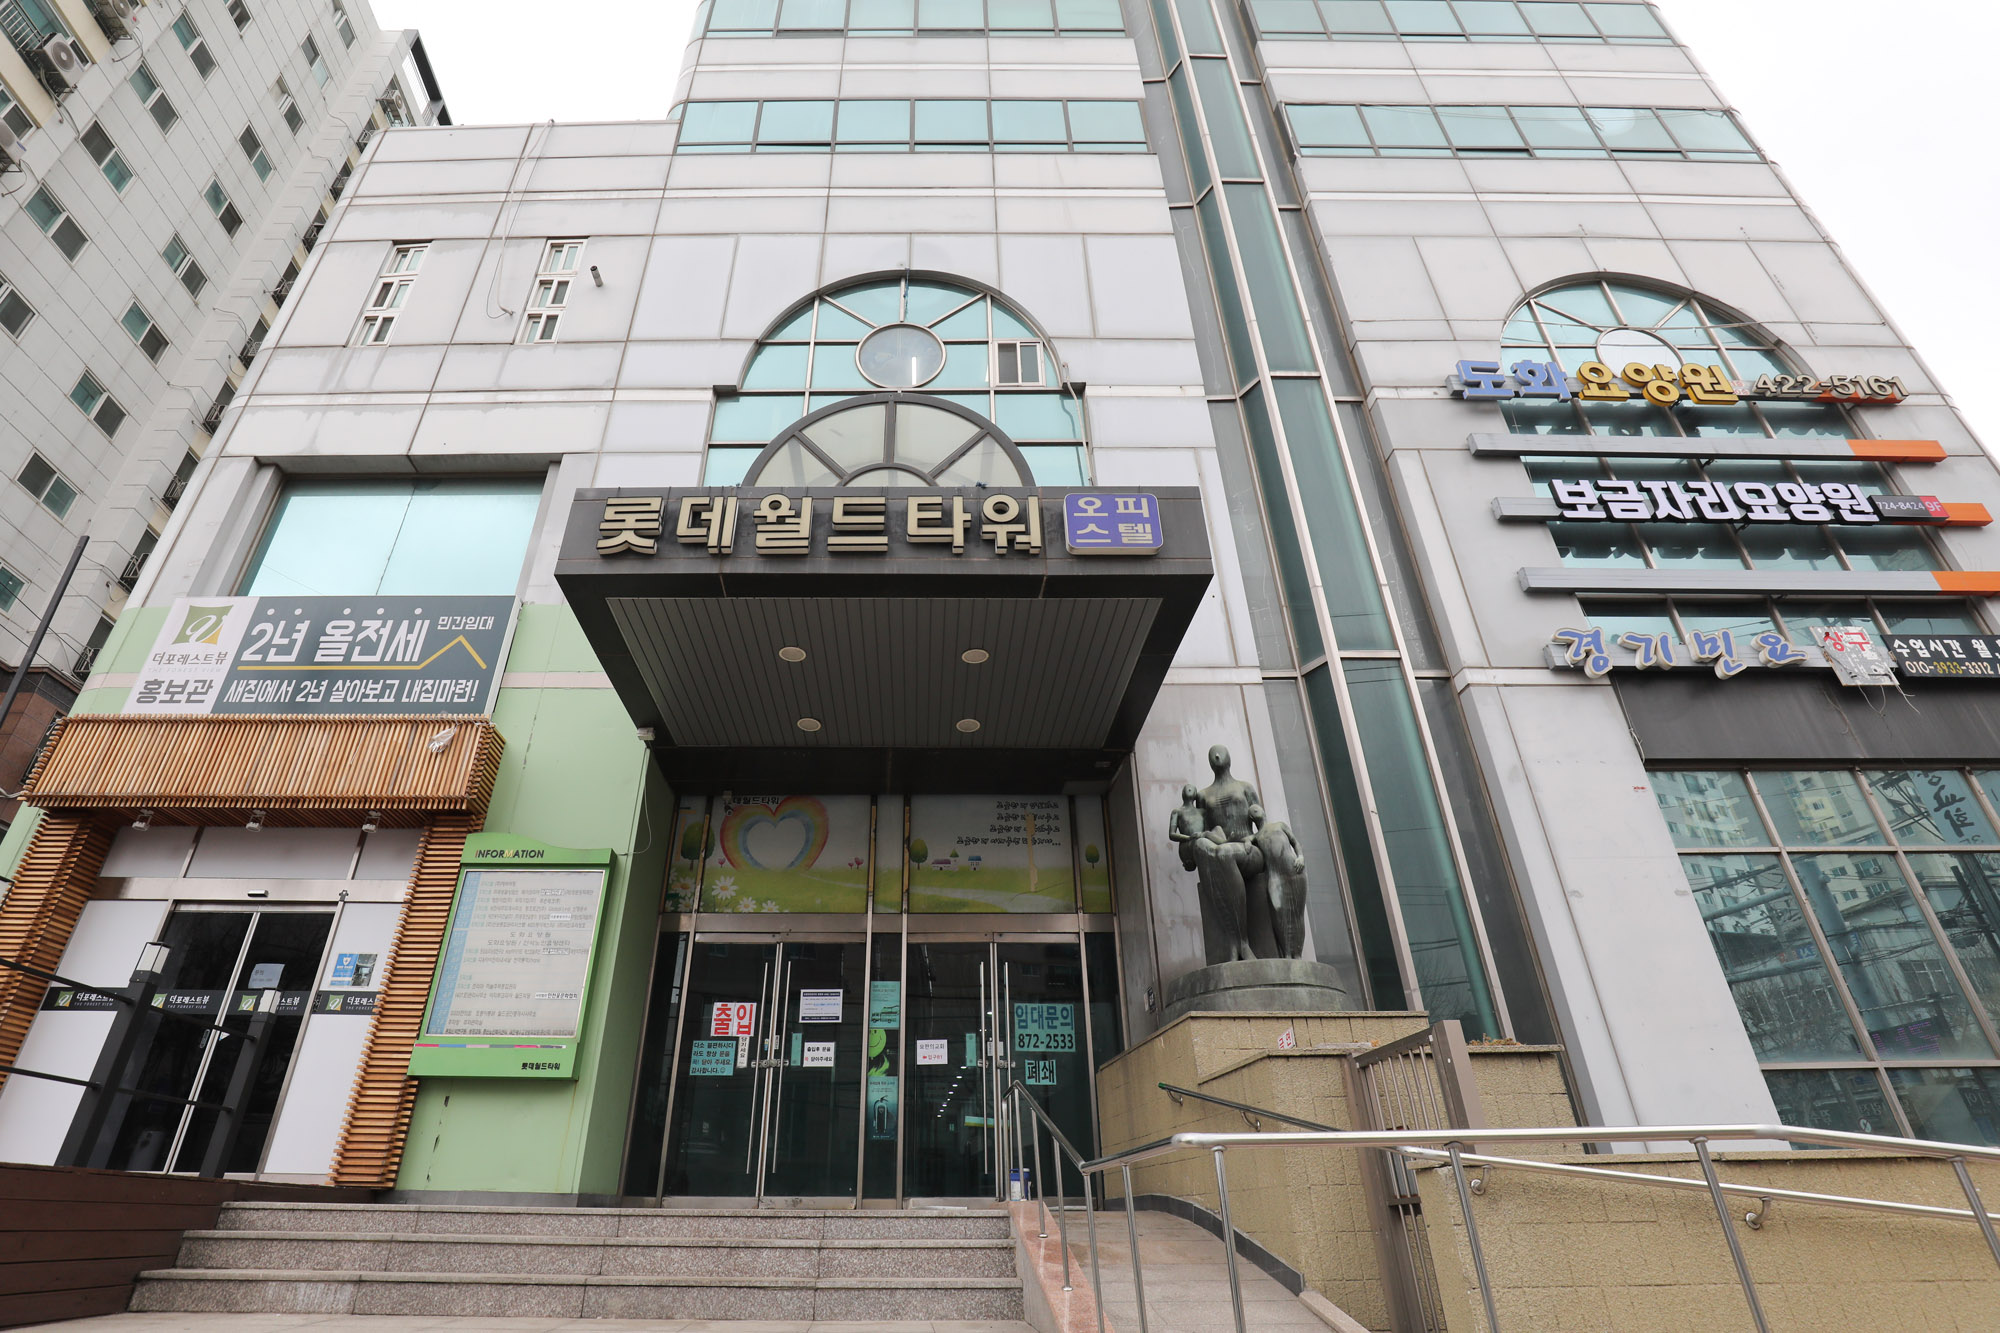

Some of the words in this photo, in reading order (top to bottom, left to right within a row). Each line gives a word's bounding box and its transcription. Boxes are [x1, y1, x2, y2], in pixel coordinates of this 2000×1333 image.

[1752, 373, 1909, 399] 422-5161
[1548, 479, 1879, 523] 보금자리요양원
[1876, 501, 1925, 510] 724-8424
[1925, 501, 1942, 512] 9F
[596, 493, 1041, 555] 롯데월드타워
[437, 616, 494, 630] 민간임대
[240, 620, 310, 663] 2년
[314, 619, 430, 663] 올전세
[1893, 638, 1967, 659] 수업시간
[152, 651, 229, 666] 더포레스트뷰
[1905, 660, 1994, 675] 010-3933-3312
[136, 678, 214, 704] 홍보관
[223, 679, 296, 703] 새집에서
[296, 680, 328, 703] 2년
[330, 679, 400, 703] 살아보고
[401, 679, 480, 703] 내집마련!
[475, 849, 545, 859] INFORMATION
[168, 995, 210, 1004] 더포레스트뷰
[714, 1003, 754, 1035] 출입
[1015, 1005, 1074, 1030] 임대문의
[1018, 1033, 1074, 1050] 872-2533
[521, 1062, 561, 1071] 롯데월드타워
[1027, 1060, 1055, 1083] 폐쇄
